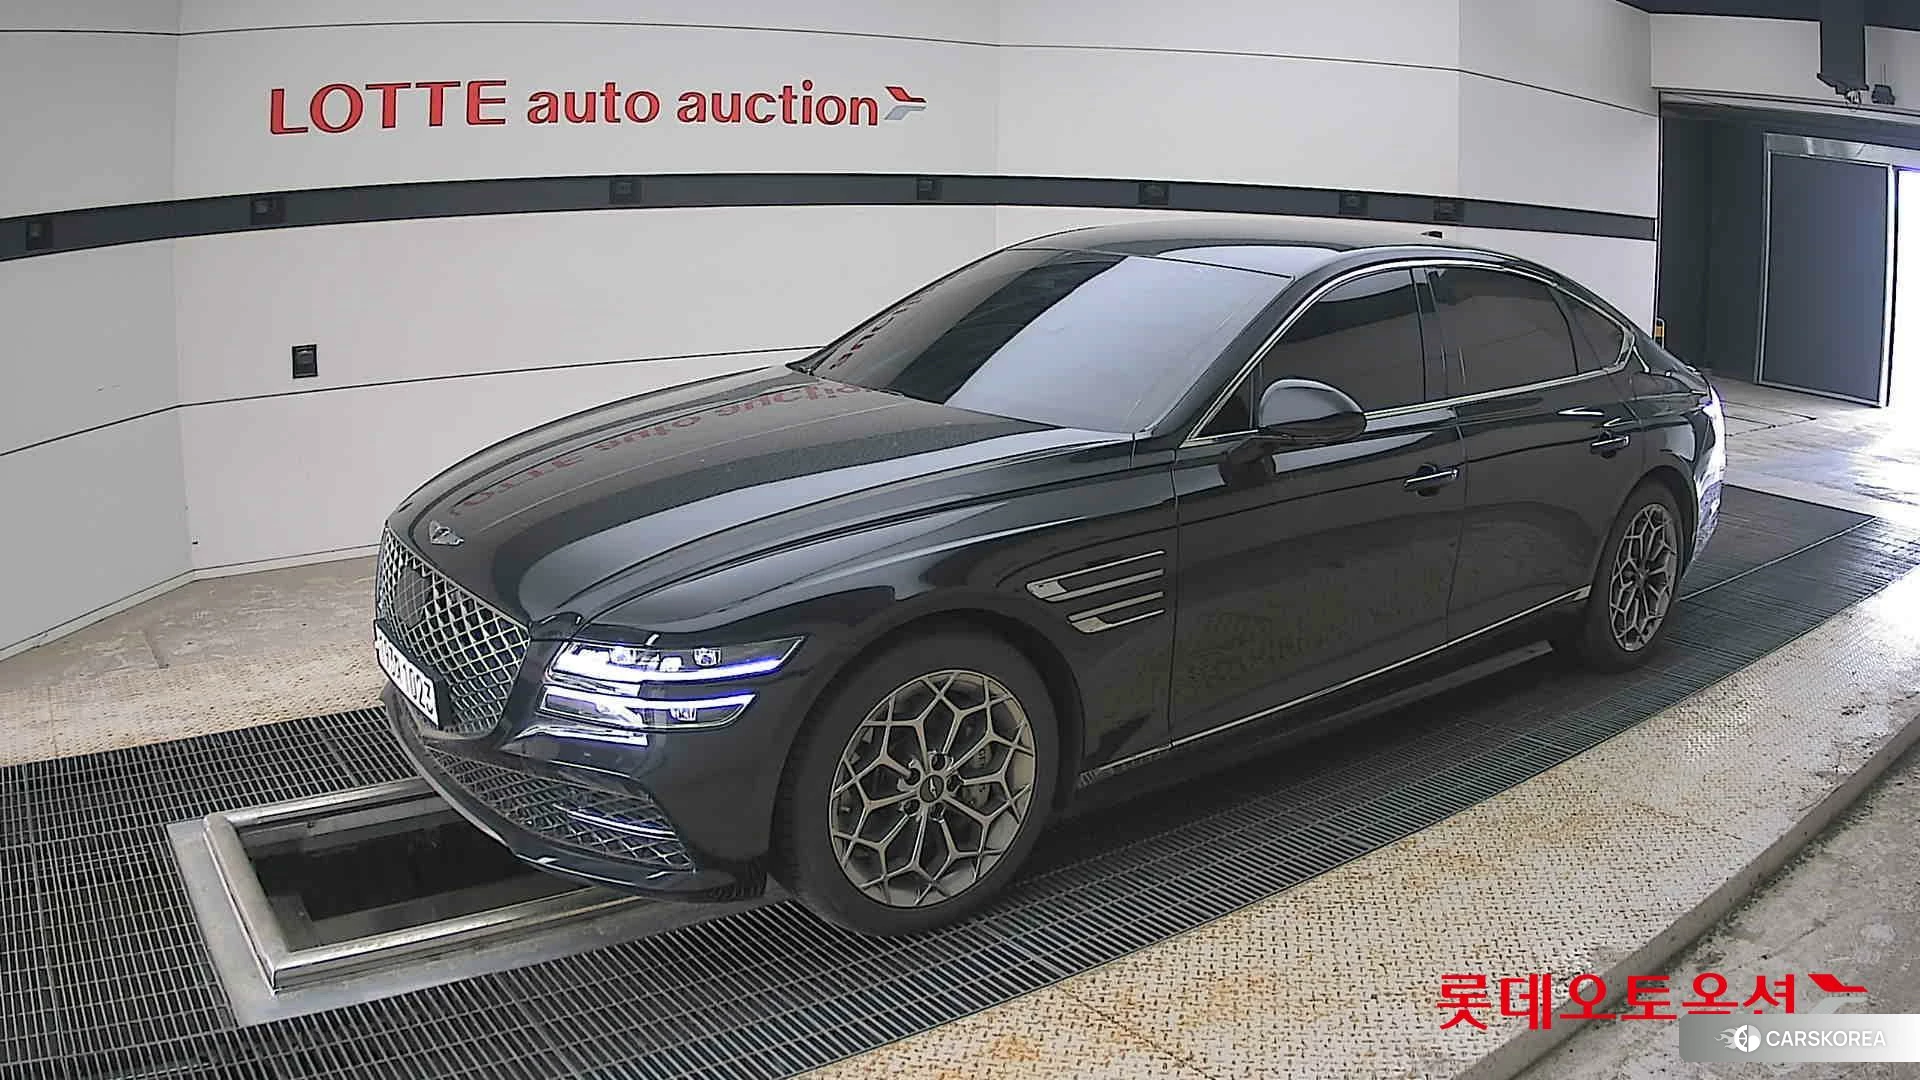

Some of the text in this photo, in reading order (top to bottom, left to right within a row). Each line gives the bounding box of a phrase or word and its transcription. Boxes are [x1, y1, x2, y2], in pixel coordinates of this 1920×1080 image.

[269, 79, 879, 135] LOTTE auto auction
